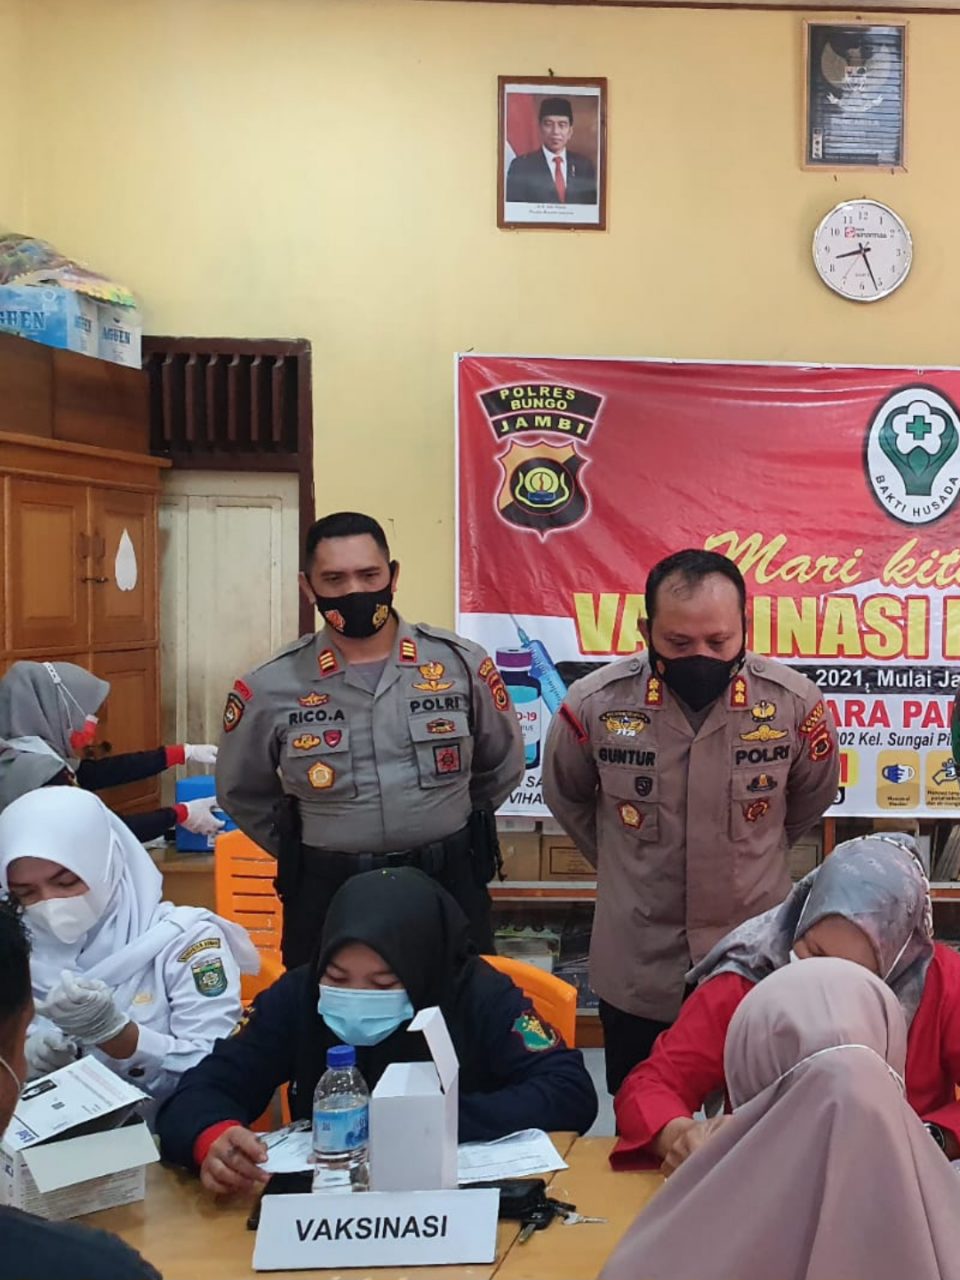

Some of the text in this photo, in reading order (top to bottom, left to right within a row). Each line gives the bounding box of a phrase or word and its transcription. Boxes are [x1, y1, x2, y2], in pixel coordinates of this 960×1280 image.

[500, 386, 576, 400] POLRES
[510, 398, 568, 411] BUNGO
[501, 415, 585, 435] JAMBI
[875, 474, 960, 517] BAKTI HUSADA
[703, 530, 866, 588] Mari
[573, 592, 929, 660] VAINASI
[815, 669, 871, 690] 2021,
[877, 669, 932, 688] Mulai
[410, 698, 462, 713] POLRI
[858, 731, 883, 746] Kel.
[887, 732, 934, 750] Sungai
[598, 746, 656, 767] GUNTUR
[735, 744, 791, 766] POLRI
[509, 791, 546, 805] VIHA
[294, 1214, 448, 1243] VAKSINASI
